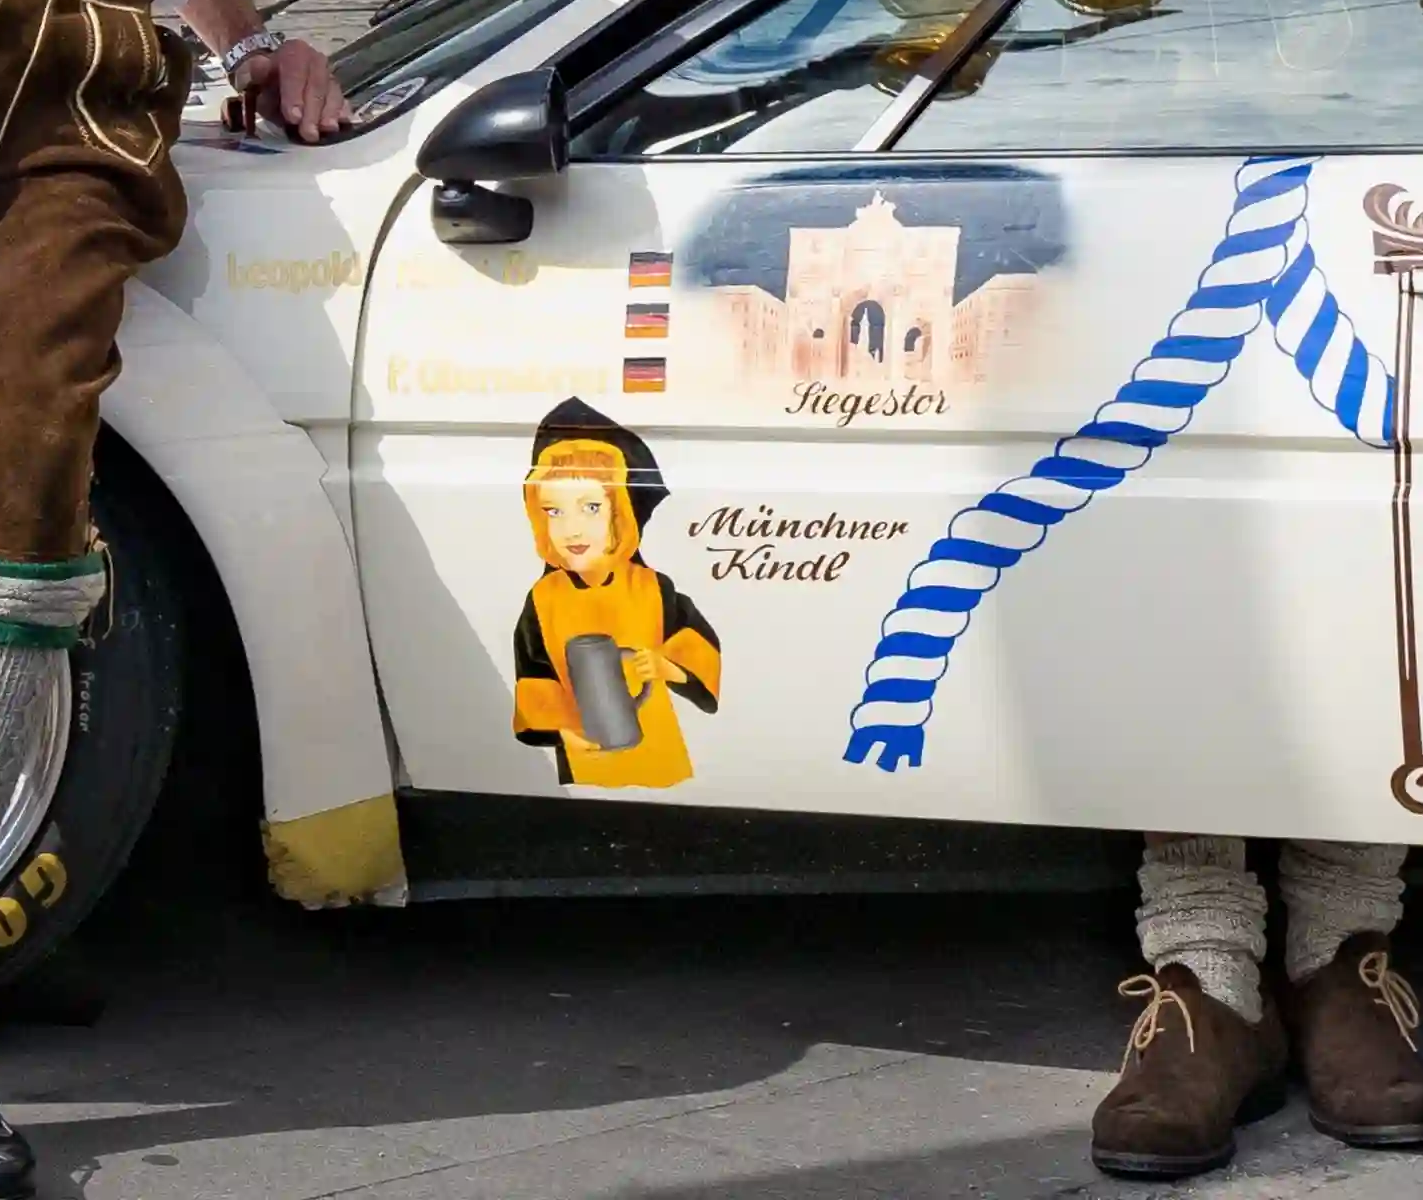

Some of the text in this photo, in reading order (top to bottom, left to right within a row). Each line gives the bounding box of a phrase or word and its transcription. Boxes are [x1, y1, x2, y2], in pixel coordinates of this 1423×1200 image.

[784, 380, 951, 428] Siegestor
[687, 503, 910, 541] Münchner
[705, 543, 851, 583] Kindl
